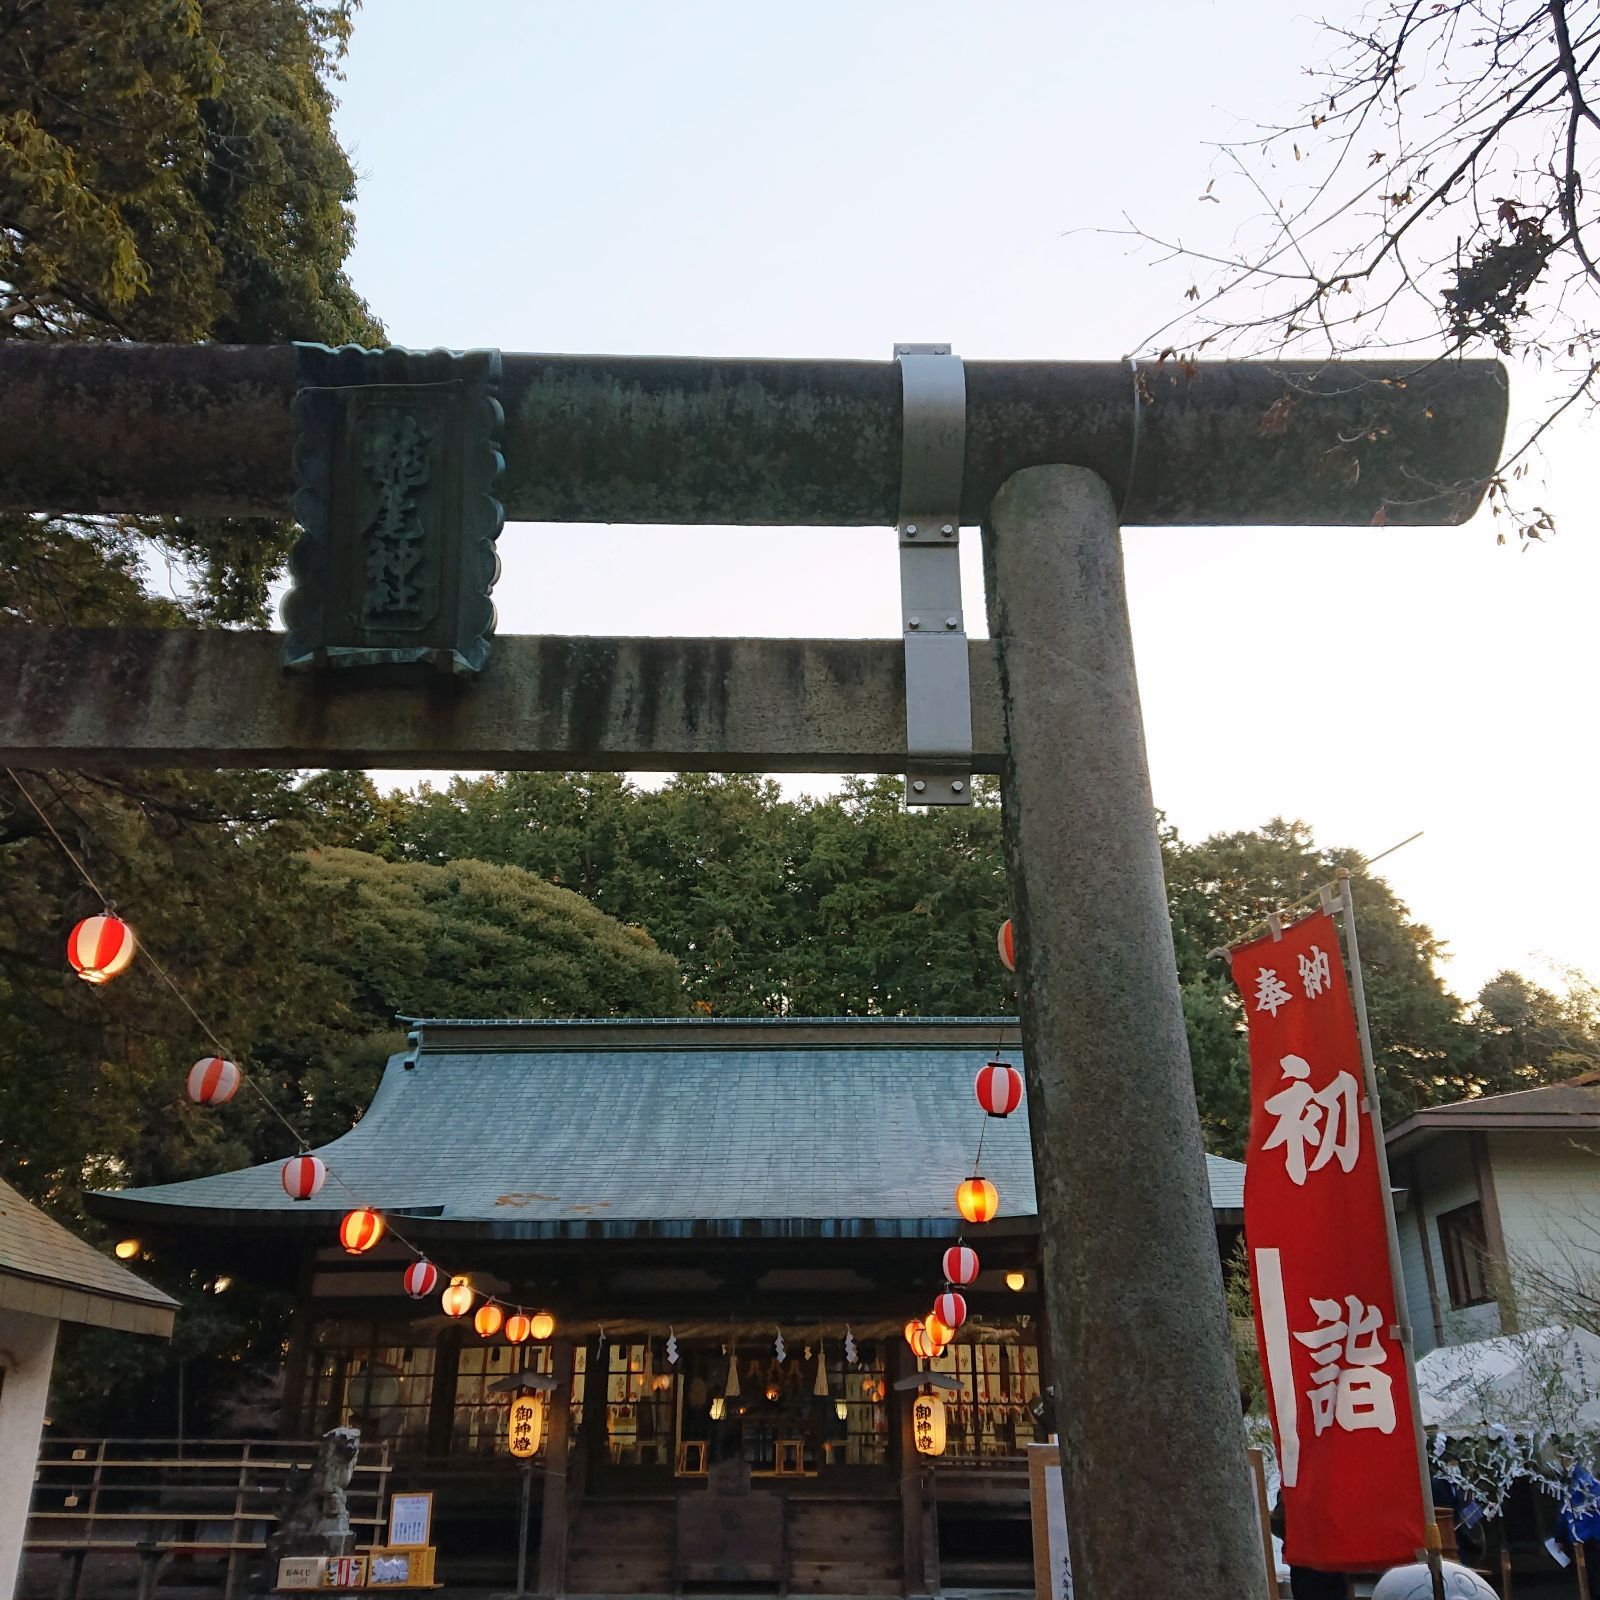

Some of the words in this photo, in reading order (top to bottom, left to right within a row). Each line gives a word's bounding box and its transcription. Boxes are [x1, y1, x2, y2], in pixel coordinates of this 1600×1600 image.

[1254, 945, 1332, 1018] 奉納
[1261, 1054, 1397, 1438] 初詣
[514, 1404, 533, 1451] 御神燈
[915, 1403, 933, 1450] 御神燈
[285, 1568, 311, 1577] おみくじ
